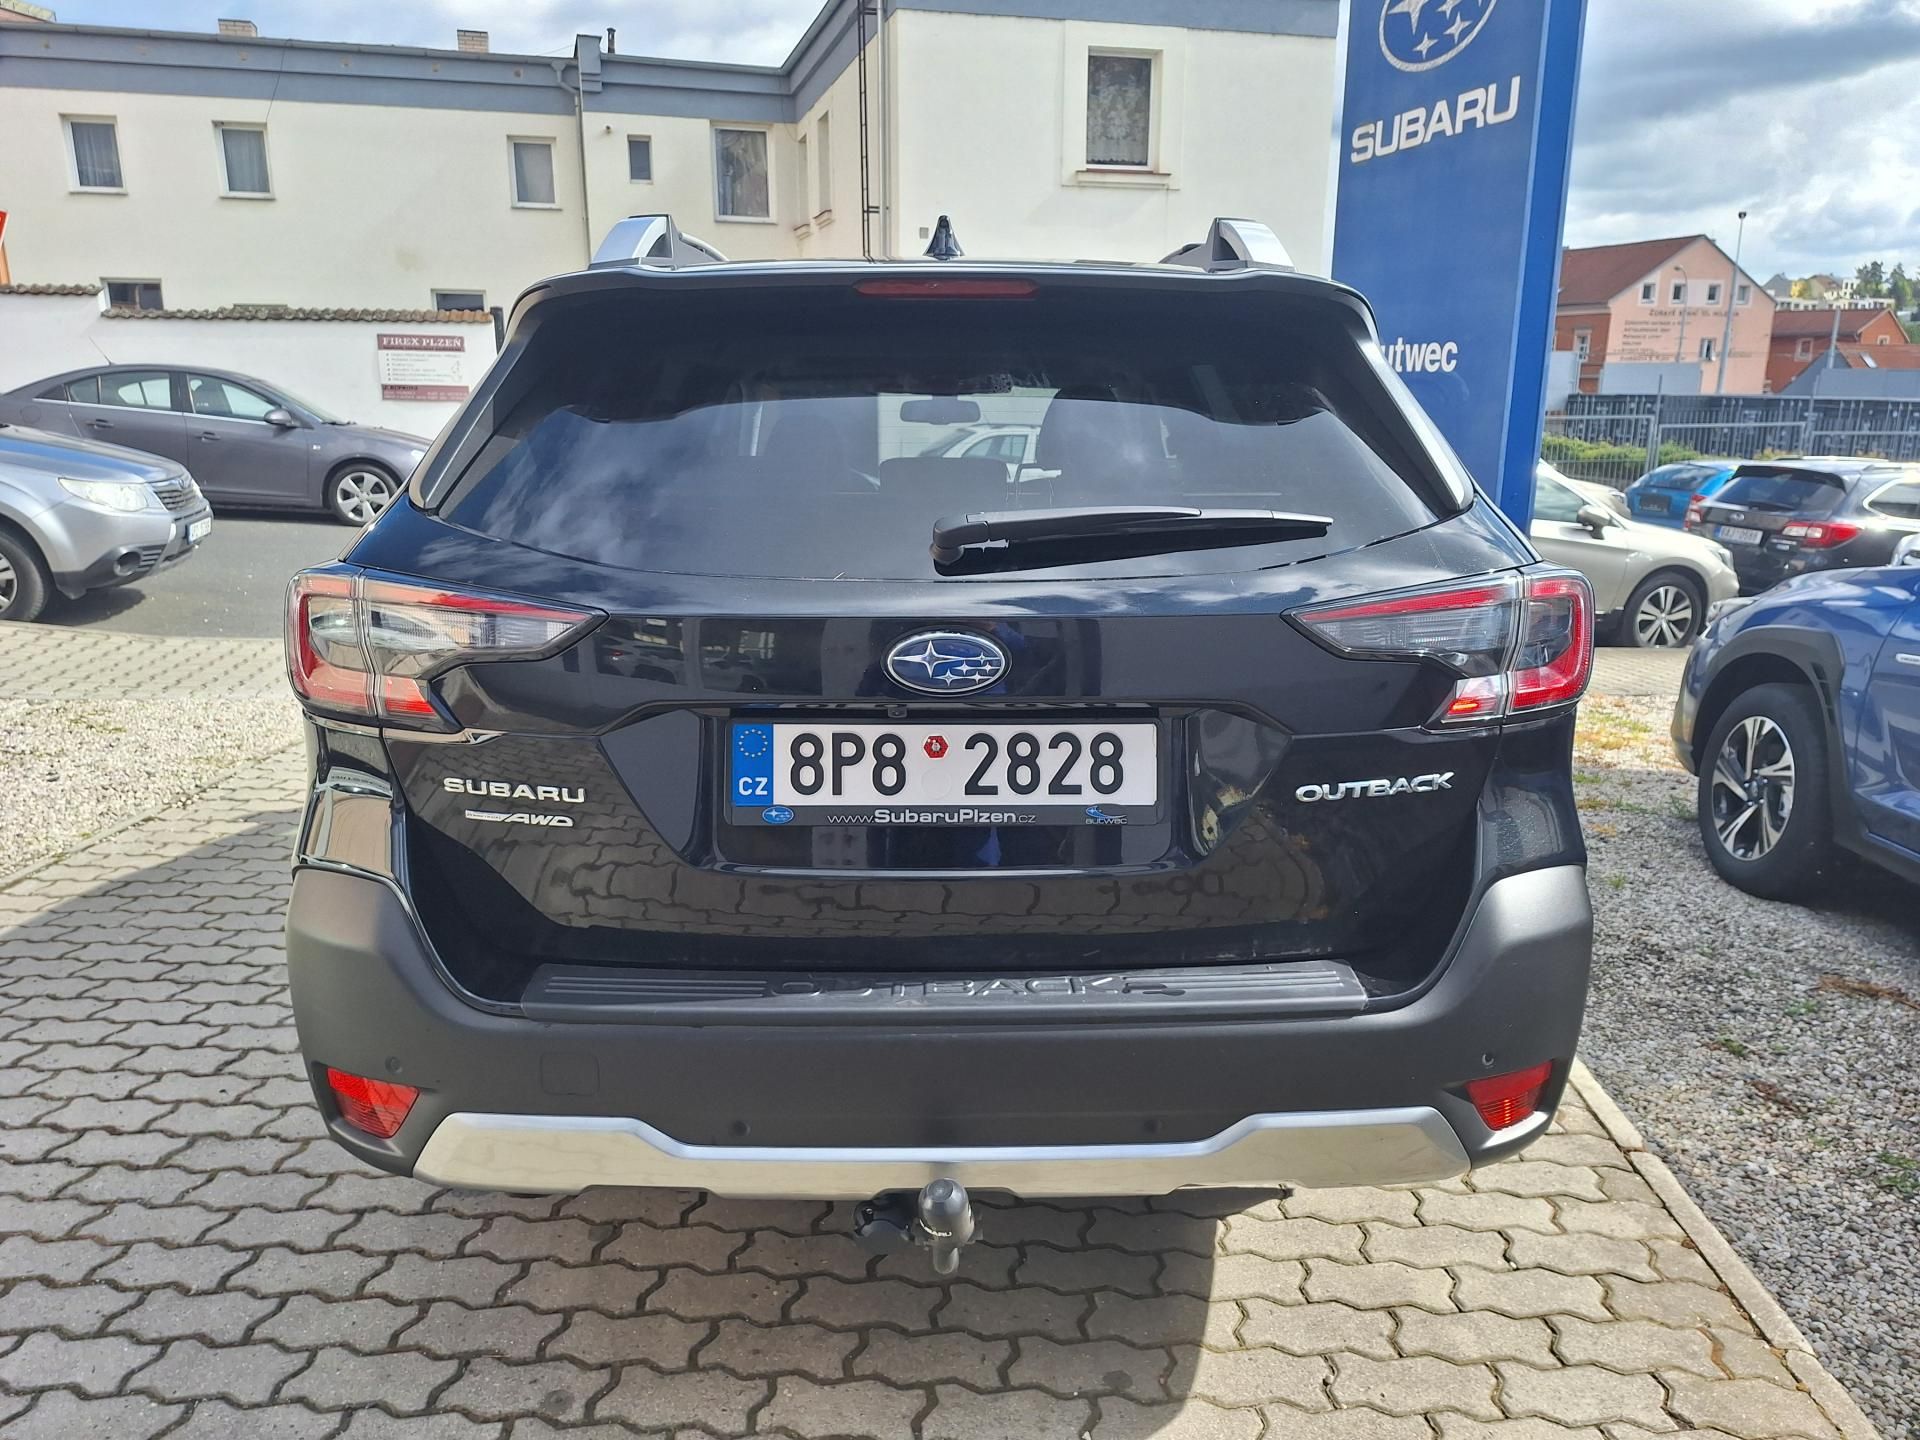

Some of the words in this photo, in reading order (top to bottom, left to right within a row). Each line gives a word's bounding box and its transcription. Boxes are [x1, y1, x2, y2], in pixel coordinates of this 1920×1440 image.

[1350, 76, 1521, 165] SUBARU
[382, 336, 419, 346] FIREX
[790, 732, 906, 797] 8P8
[964, 732, 1125, 797] 2828
[443, 777, 585, 803] SUBARU
[738, 776, 768, 796] CZ
[1295, 771, 1454, 803] OUTBACK
[504, 812, 574, 827] AWD
[827, 808, 1036, 824] www.SubaruPlzen.cz
